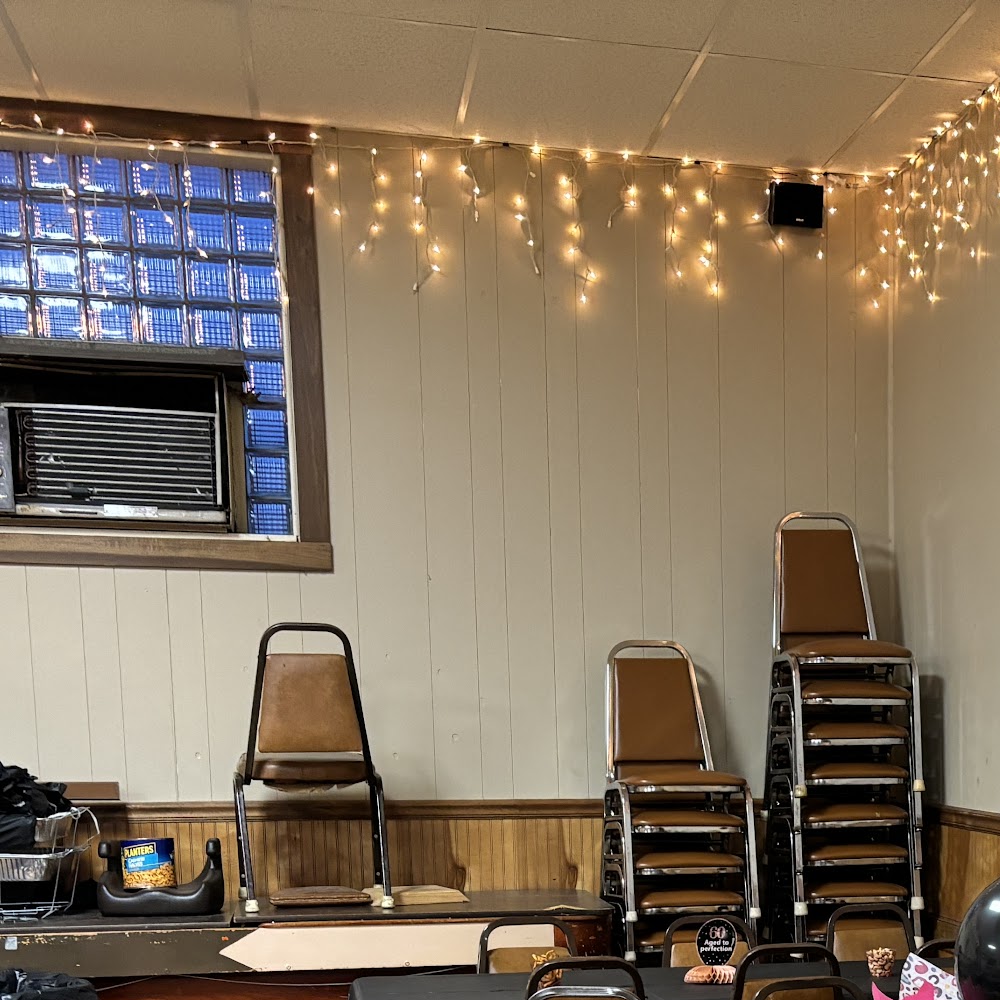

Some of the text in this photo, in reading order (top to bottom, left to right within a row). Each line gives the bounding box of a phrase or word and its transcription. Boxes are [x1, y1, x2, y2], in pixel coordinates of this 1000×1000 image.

[124, 845, 154, 858] PLANTERS
[710, 926, 727, 939] 60
[704, 939, 721, 947] Aged
[700, 945, 733, 953] perfection
